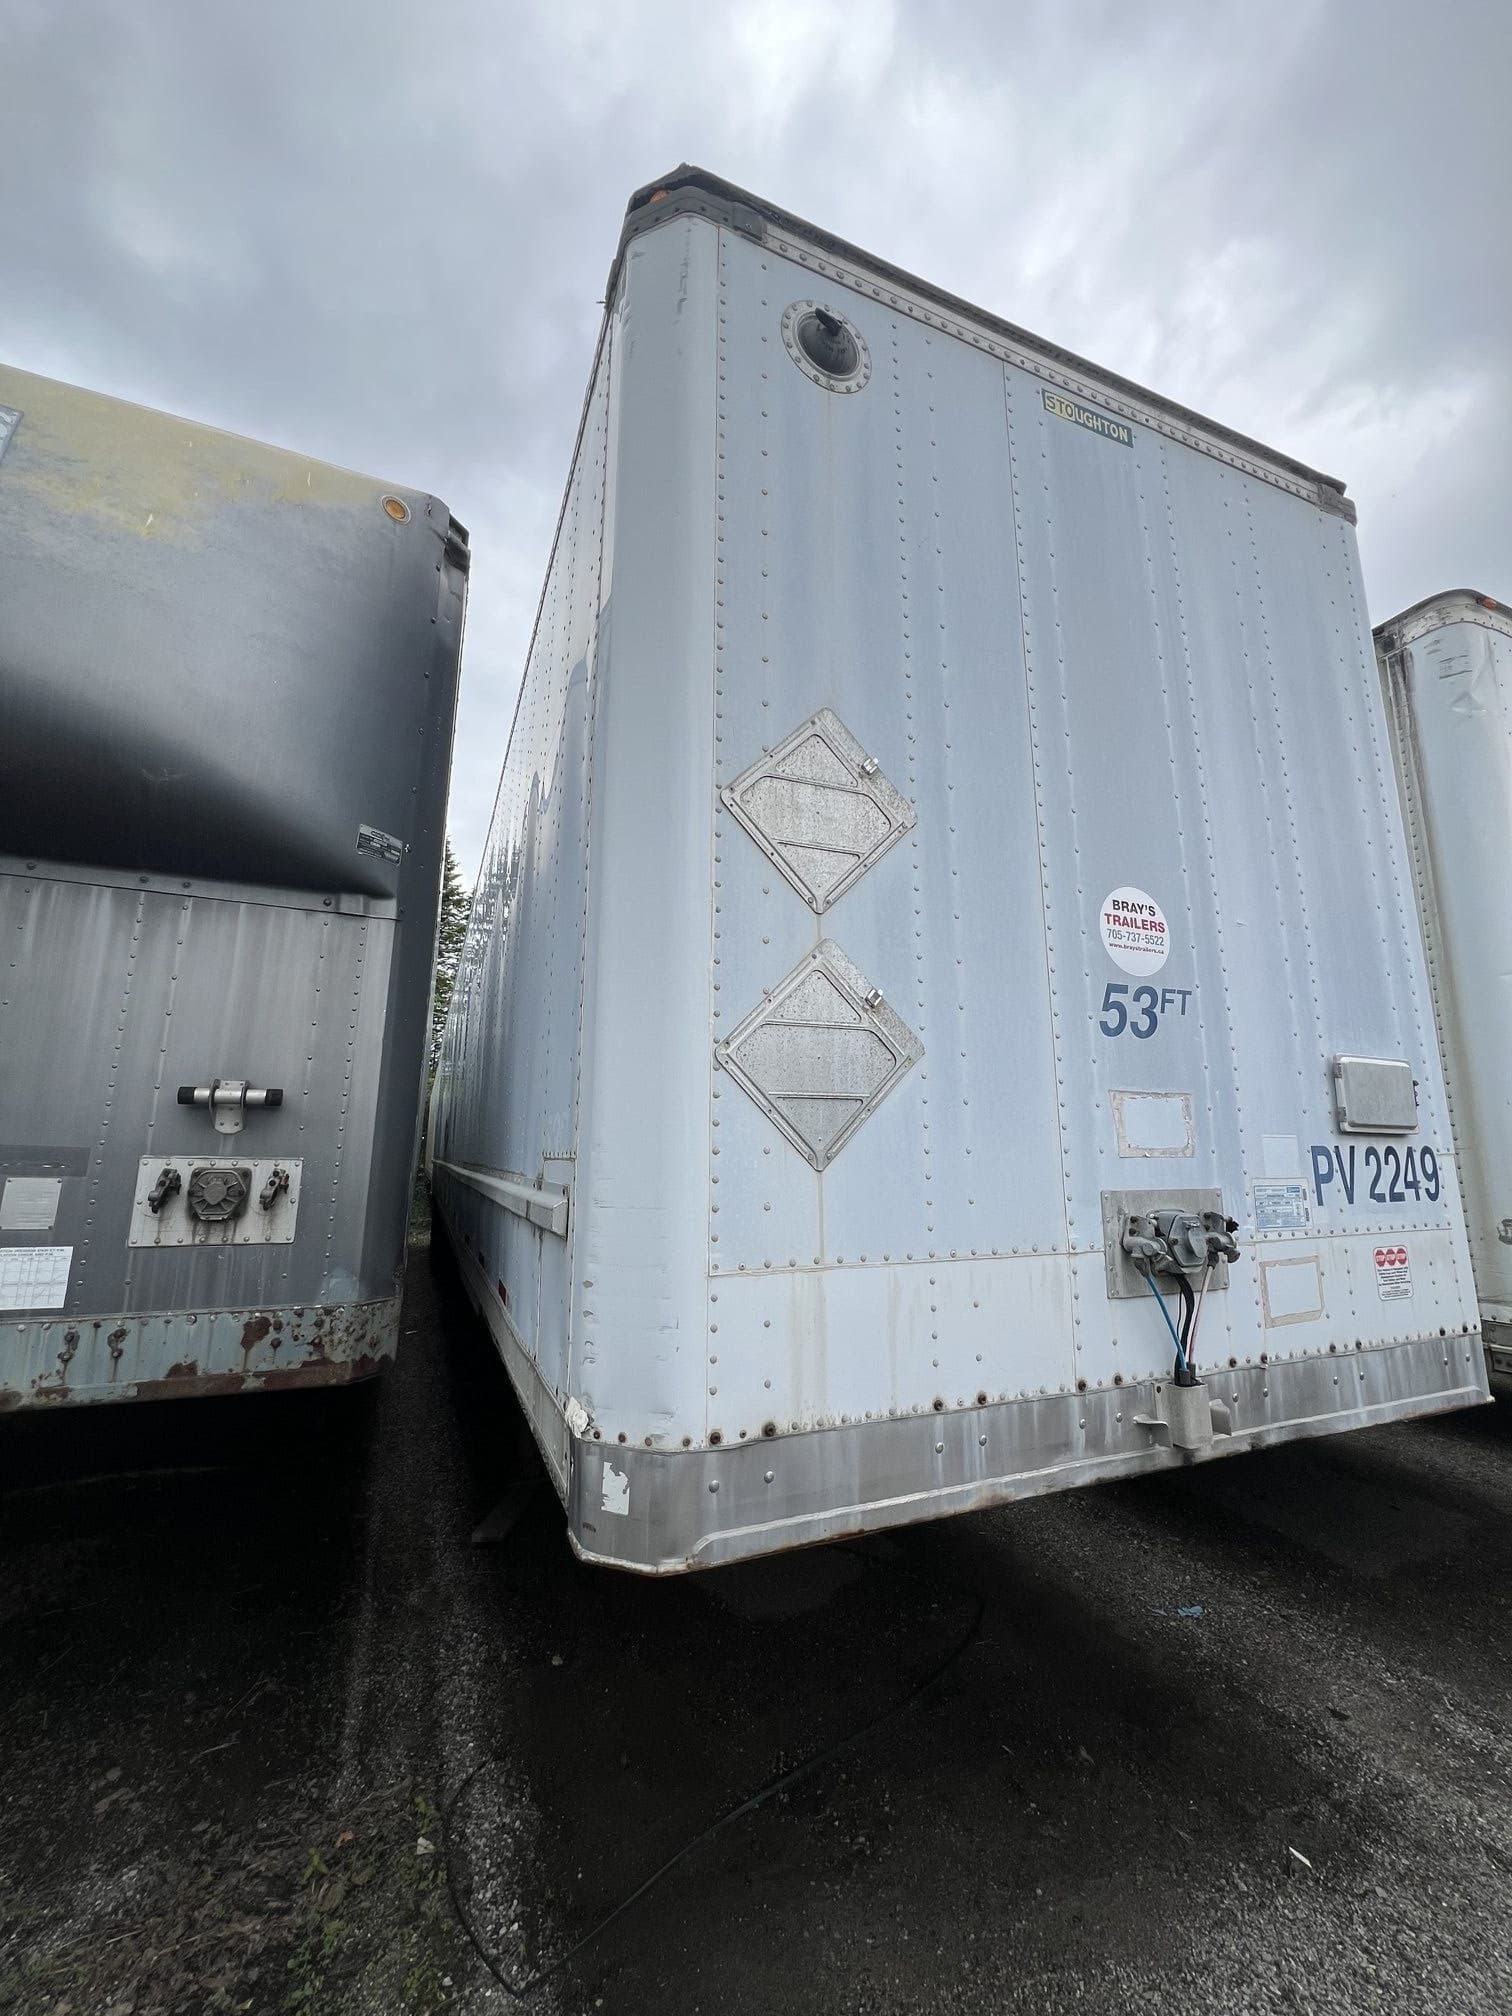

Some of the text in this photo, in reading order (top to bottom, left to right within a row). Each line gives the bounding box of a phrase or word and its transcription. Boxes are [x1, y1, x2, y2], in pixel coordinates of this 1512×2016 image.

[1046, 395, 1128, 442] STOUGHTON
[1112, 899, 1156, 917] BRAY'S
[1104, 913, 1165, 933] TRAILERS
[1107, 928, 1165, 946] 705-737-5522
[1365, 1145, 1440, 1203] 2249
